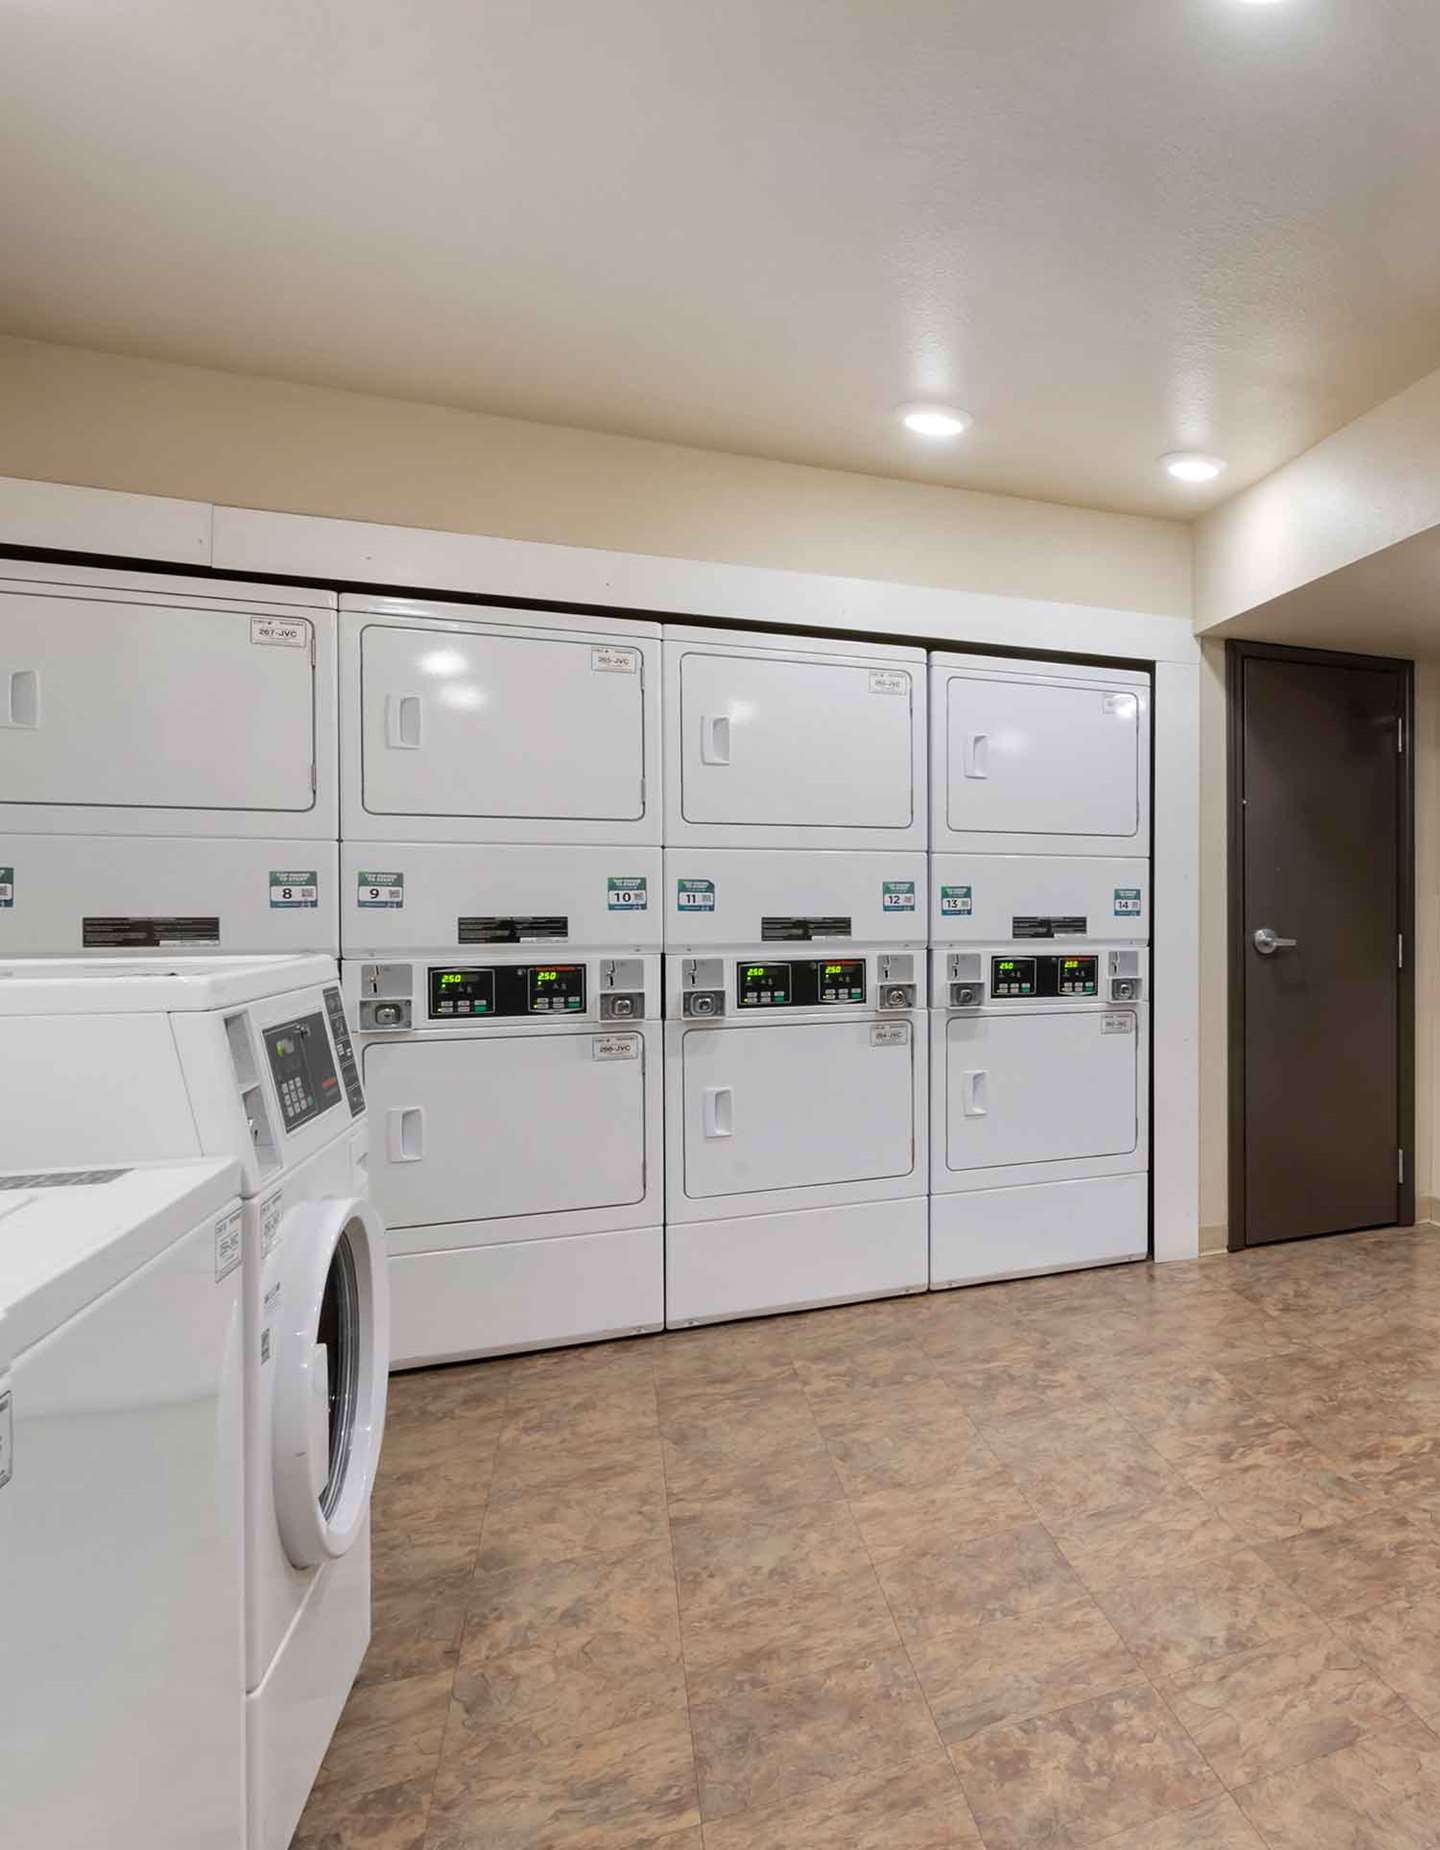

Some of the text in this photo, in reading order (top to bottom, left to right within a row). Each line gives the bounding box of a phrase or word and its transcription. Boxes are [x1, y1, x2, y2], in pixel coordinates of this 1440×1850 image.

[282, 888, 292, 899] 8
[369, 888, 379, 899] 9
[614, 892, 631, 902] 10
[686, 894, 696, 903] 11
[888, 896, 901, 905] 12
[946, 899, 958, 908] 13
